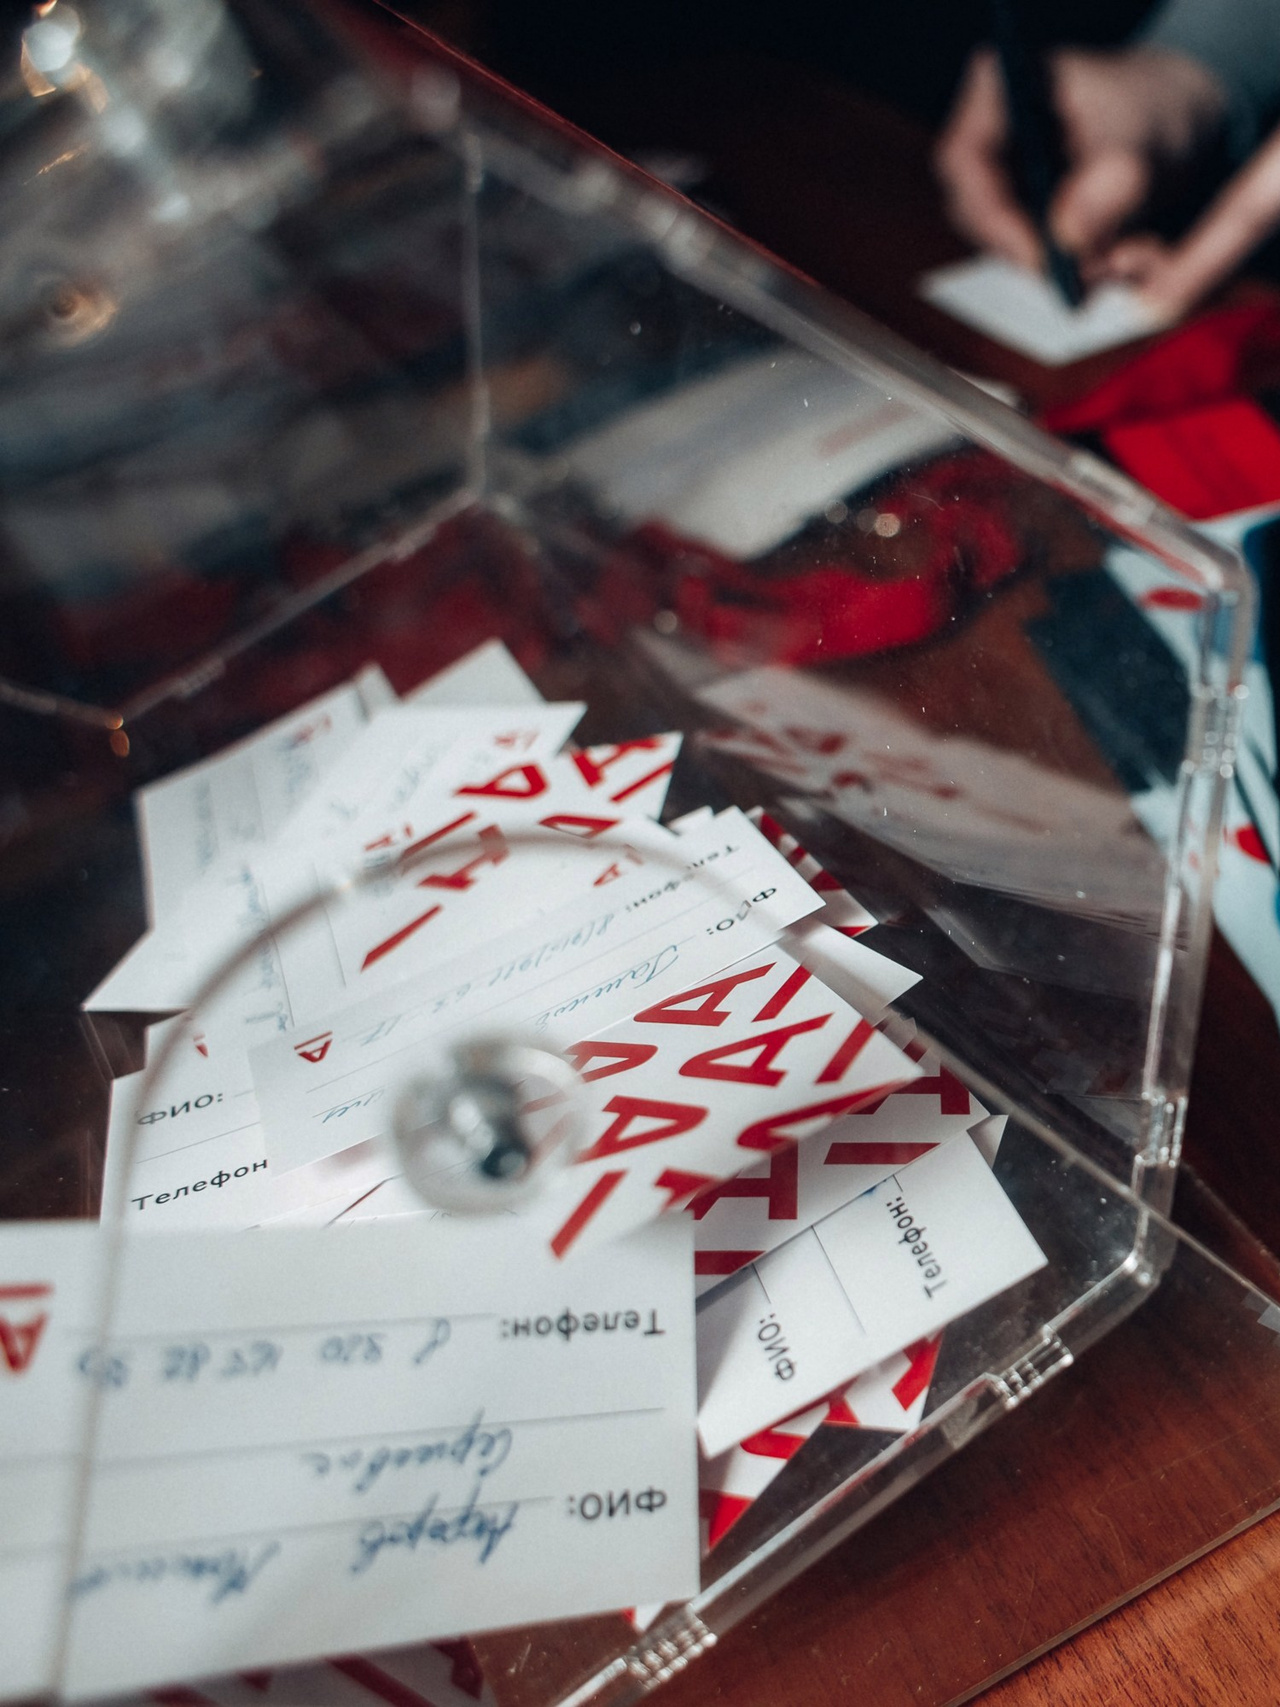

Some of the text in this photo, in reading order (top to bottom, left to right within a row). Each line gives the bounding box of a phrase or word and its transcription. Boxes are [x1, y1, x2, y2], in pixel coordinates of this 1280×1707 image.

[137, 1093, 223, 1126] ФИО:
[886, 1196, 948, 1300] Телефон:
[501, 1307, 667, 1341] Телефон:
[757, 1312, 798, 1382] ФИО:
[566, 1485, 669, 1521] ФИО:
